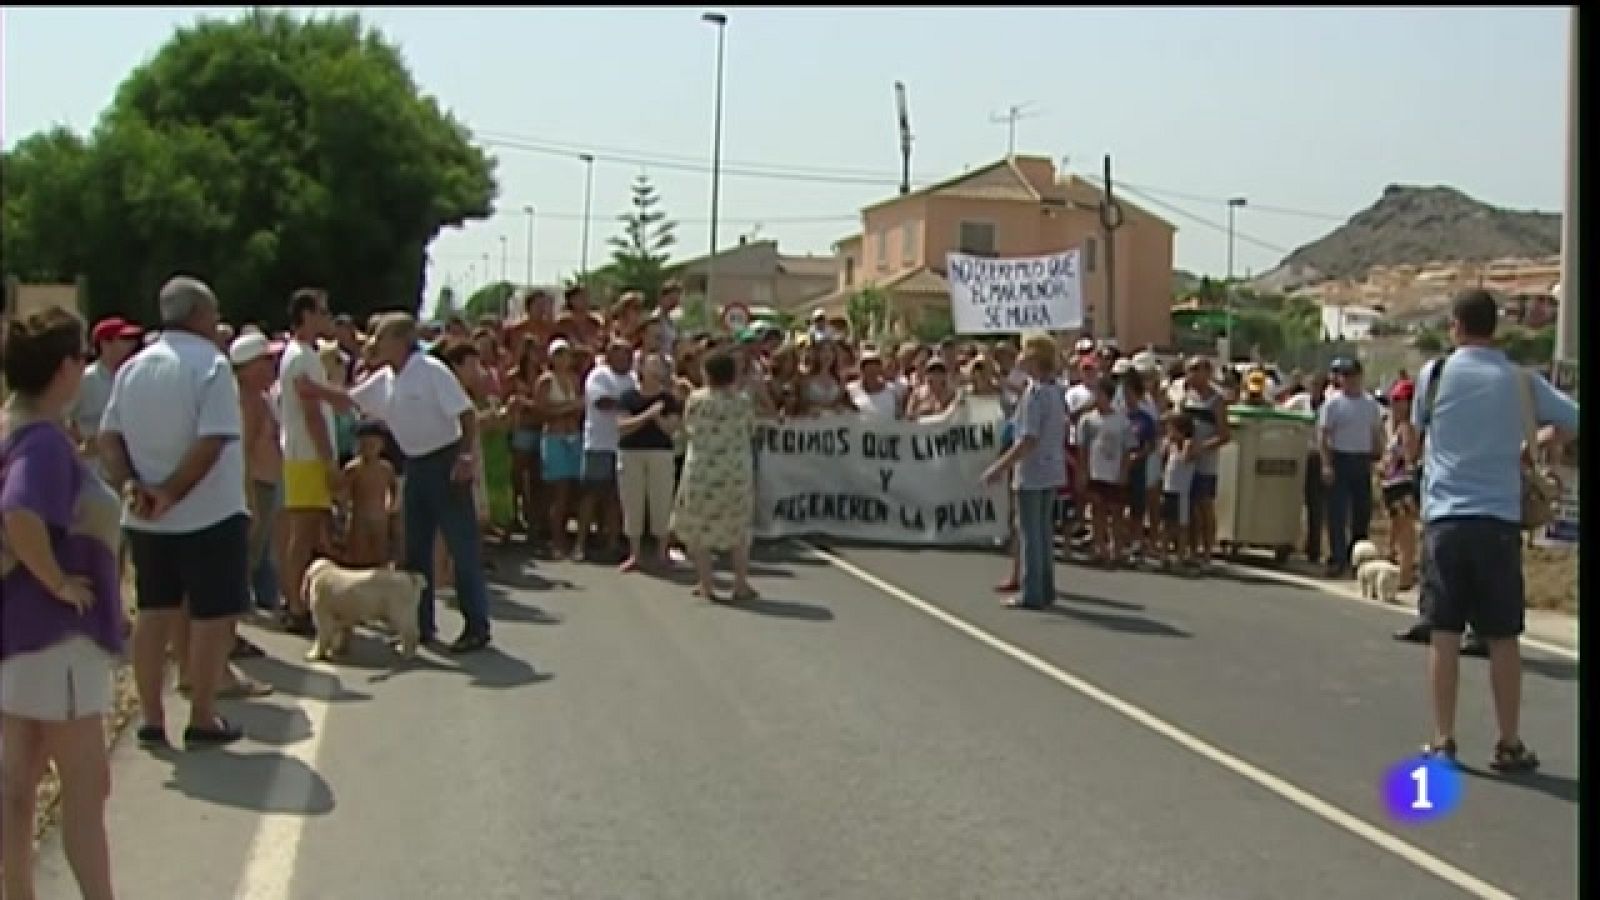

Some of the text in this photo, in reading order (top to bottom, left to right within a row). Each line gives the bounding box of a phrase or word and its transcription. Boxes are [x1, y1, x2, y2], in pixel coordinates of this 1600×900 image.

[862, 431, 901, 461] QUE
[912, 423, 994, 461] LIMPIEN
[879, 468, 894, 493] Y
[900, 502, 925, 531] LA
[935, 497, 997, 531] PLAYA
